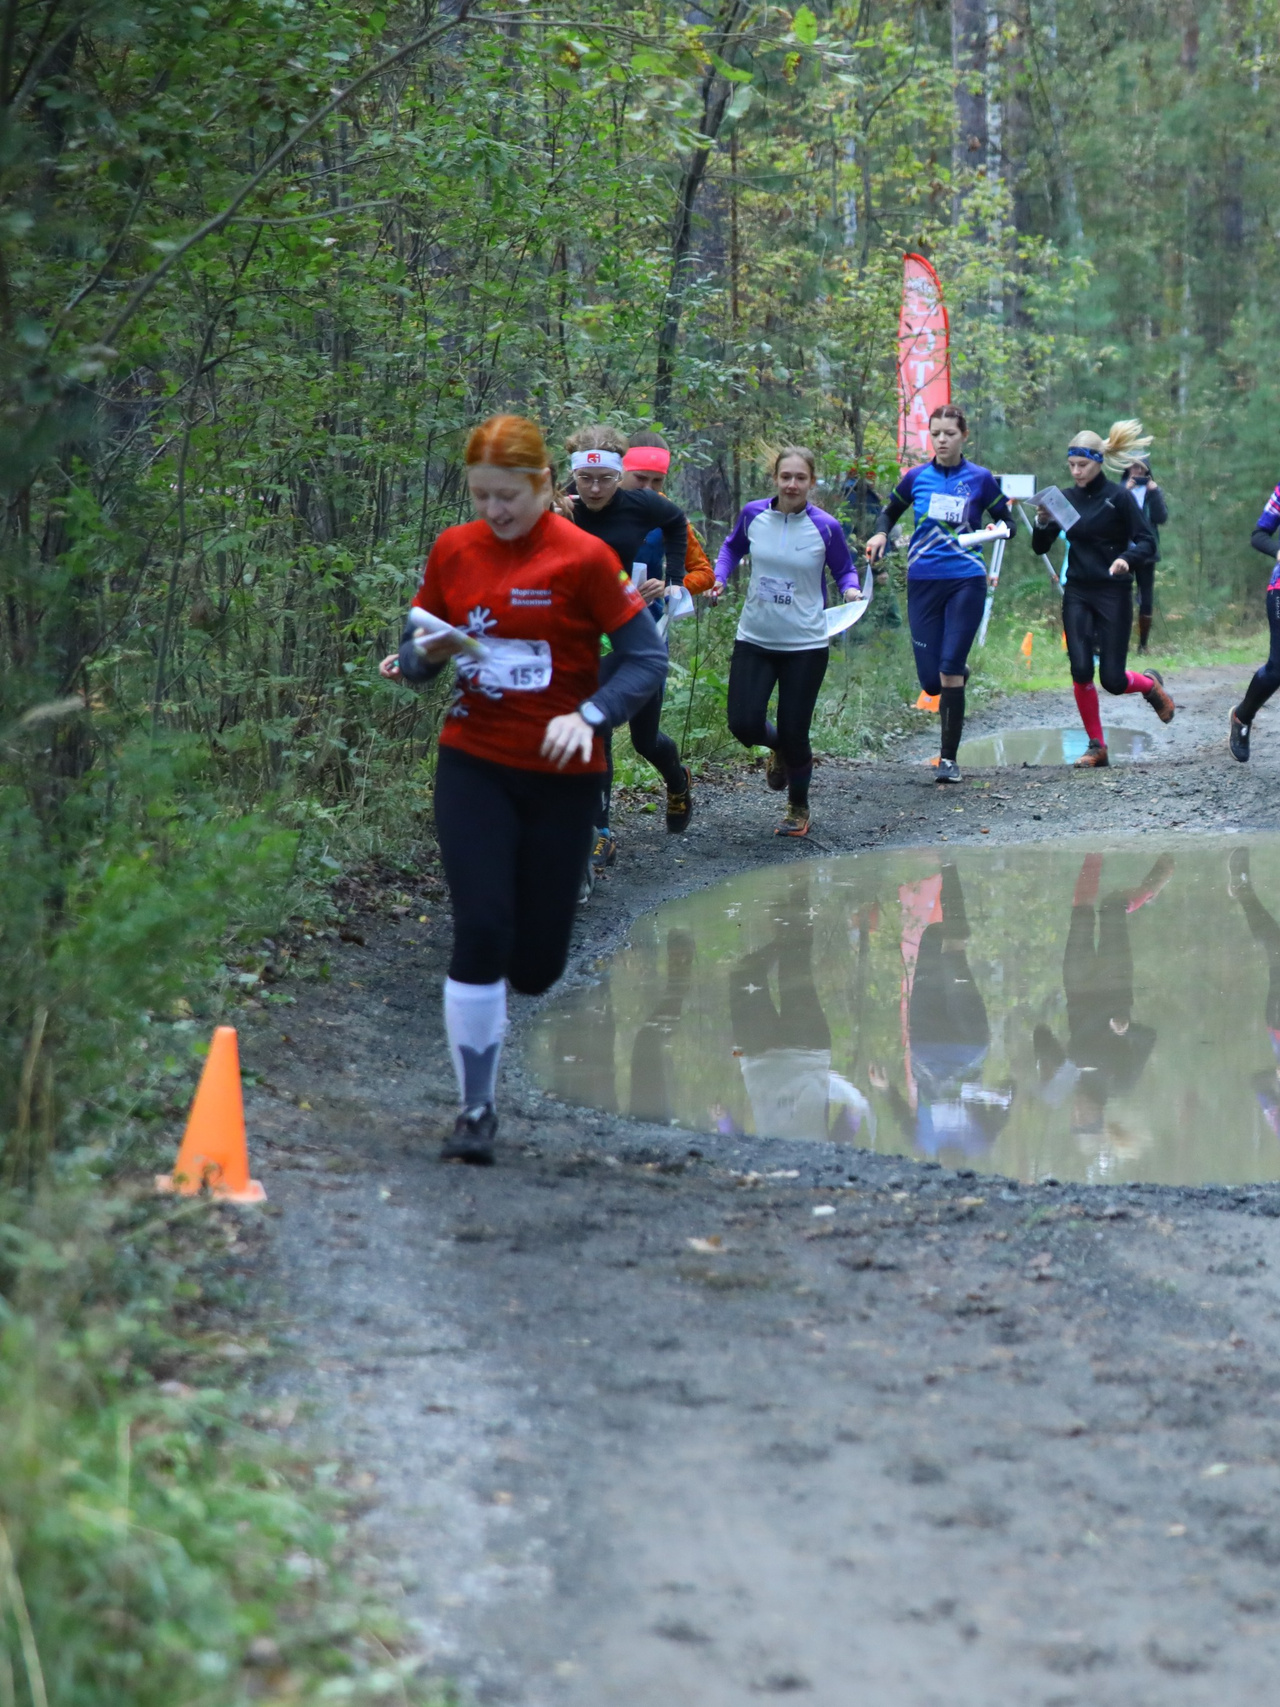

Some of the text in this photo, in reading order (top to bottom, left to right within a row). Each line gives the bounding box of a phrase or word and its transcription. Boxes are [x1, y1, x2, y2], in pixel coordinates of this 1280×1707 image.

[945, 511, 960, 522] 151
[773, 594, 792, 605] 158
[509, 667, 545, 686] 153
